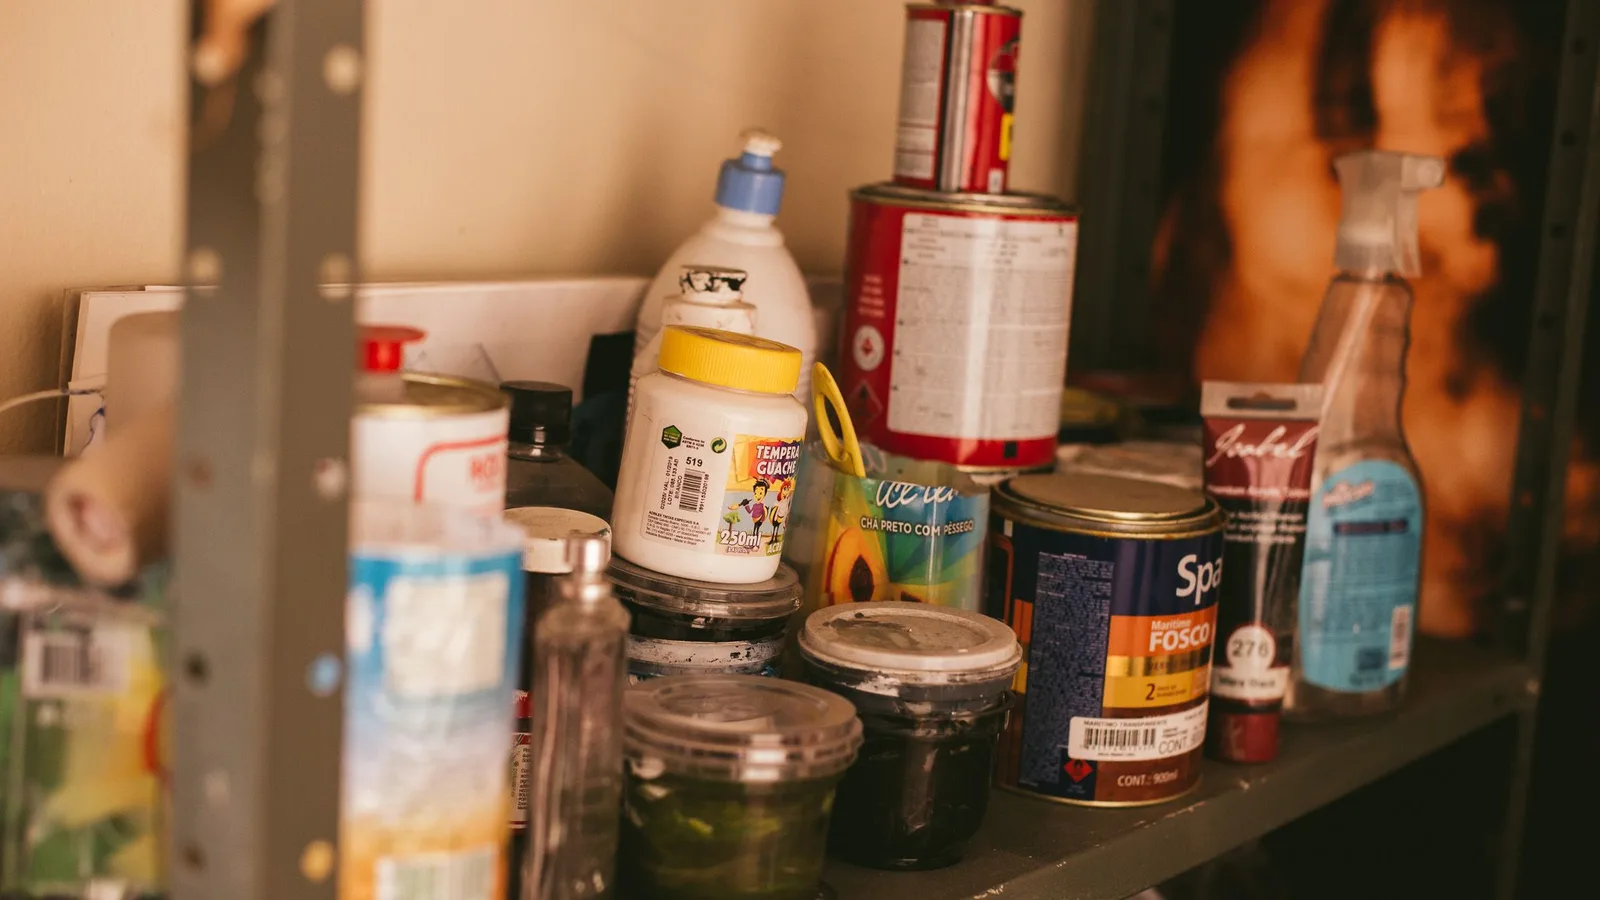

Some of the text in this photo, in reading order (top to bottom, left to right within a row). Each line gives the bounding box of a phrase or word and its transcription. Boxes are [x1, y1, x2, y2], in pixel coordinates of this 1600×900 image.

[756, 444, 800, 460] TEMPERA
[685, 456, 703, 467] 519
[756, 460, 797, 475] GUACHE
[860, 516, 879, 530] CHÁ
[880, 520, 912, 534] PRETO
[914, 524, 941, 537] COM
[719, 531, 762, 547] 250ml
[1176, 553, 1222, 605] Spa
[1148, 621, 1210, 652] FOSCO
[1231, 639, 1269, 658] 276
[1145, 683, 1155, 701] 2
[1152, 770, 1178, 784] 900ml
